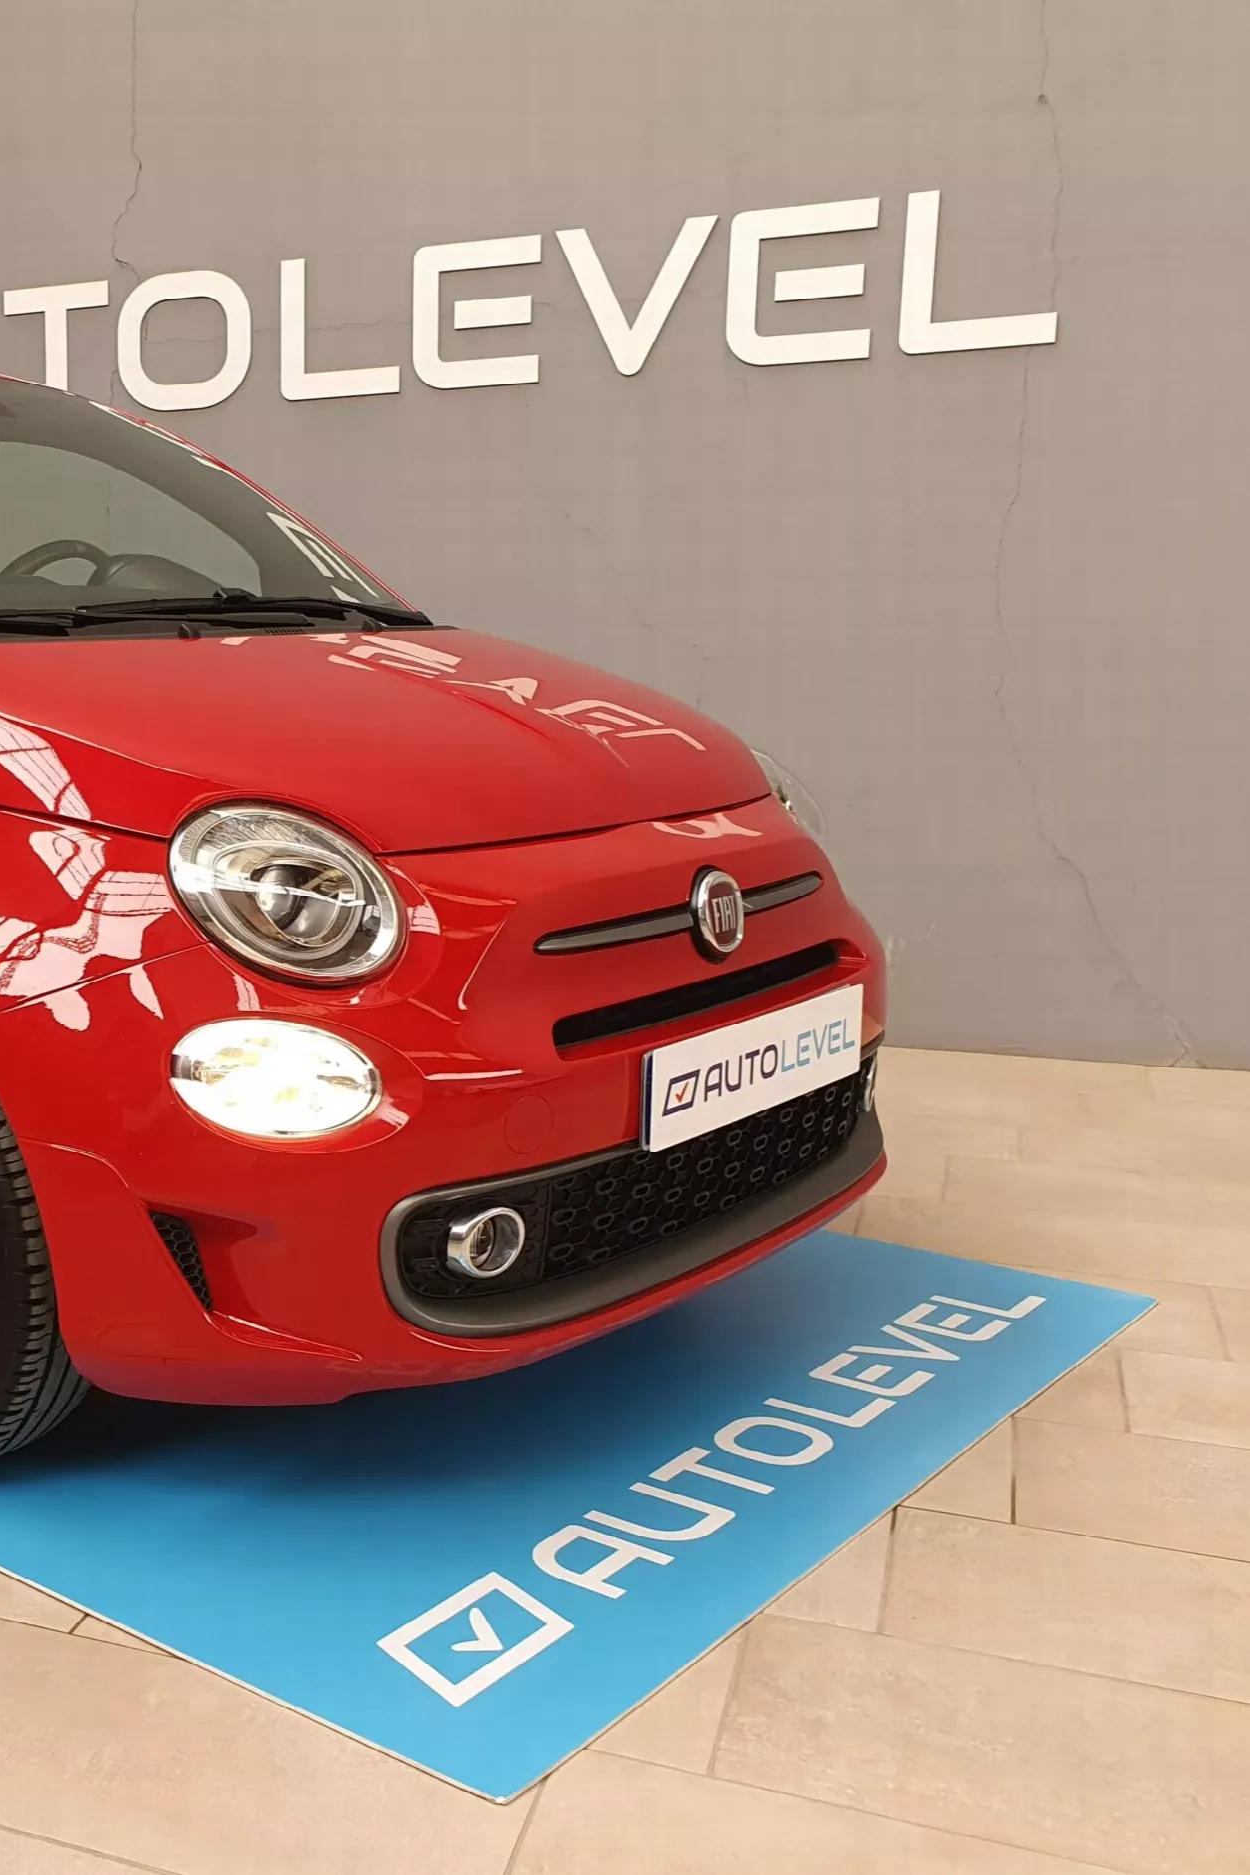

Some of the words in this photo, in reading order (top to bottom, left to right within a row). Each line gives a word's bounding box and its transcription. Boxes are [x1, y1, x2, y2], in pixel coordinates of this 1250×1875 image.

[711, 895, 737, 933] FIAT
[703, 1018, 855, 1102] AUTOLEVEL
[532, 1295, 1047, 1599] AUTOLEVEL
